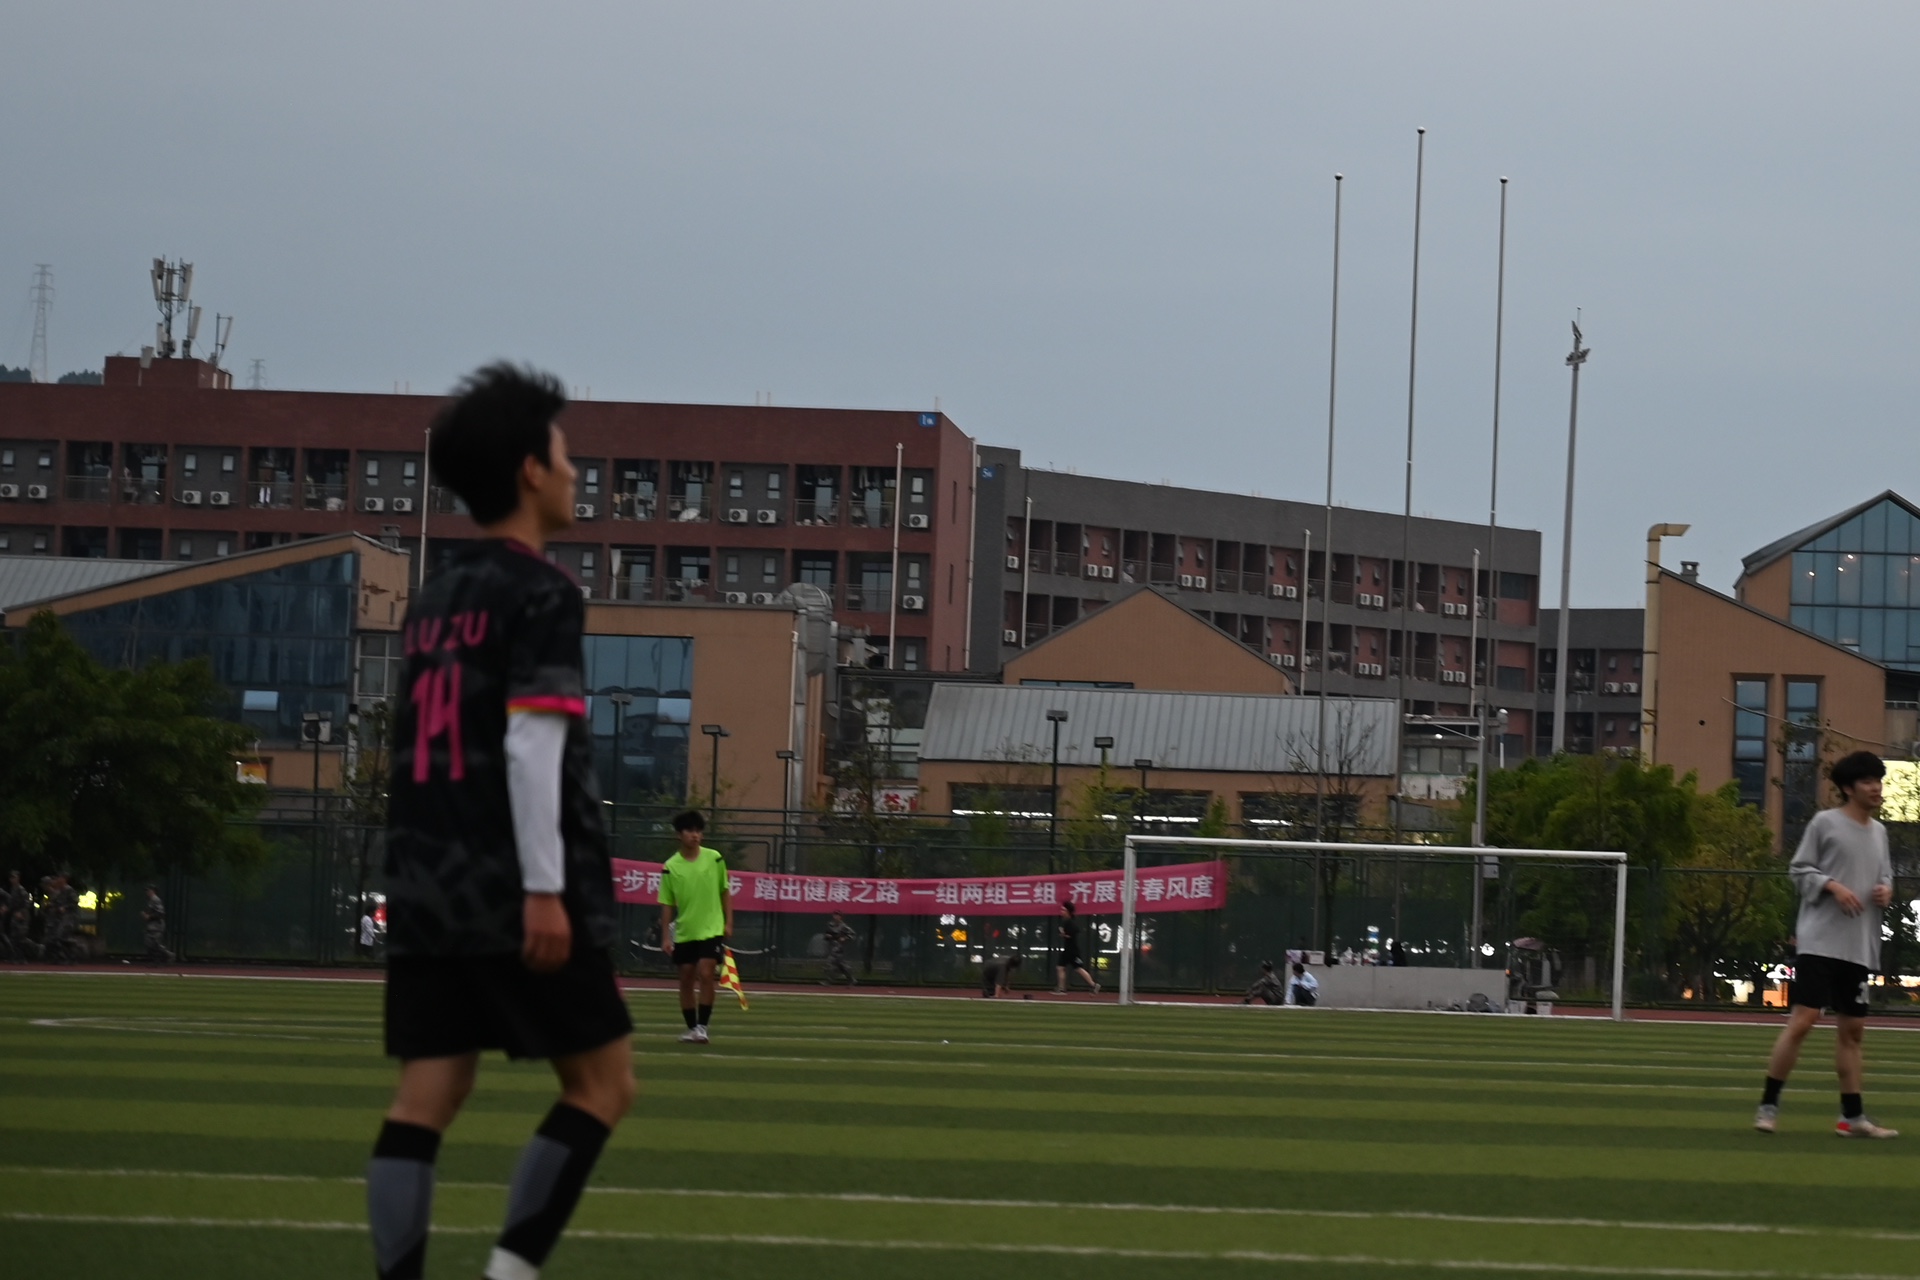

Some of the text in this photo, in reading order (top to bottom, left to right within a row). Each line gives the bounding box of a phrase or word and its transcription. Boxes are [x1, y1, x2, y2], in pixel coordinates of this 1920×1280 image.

[412, 661, 465, 784] 14
[754, 877, 900, 904] 踏出健康之路
[911, 882, 1057, 905] 一组两组三组
